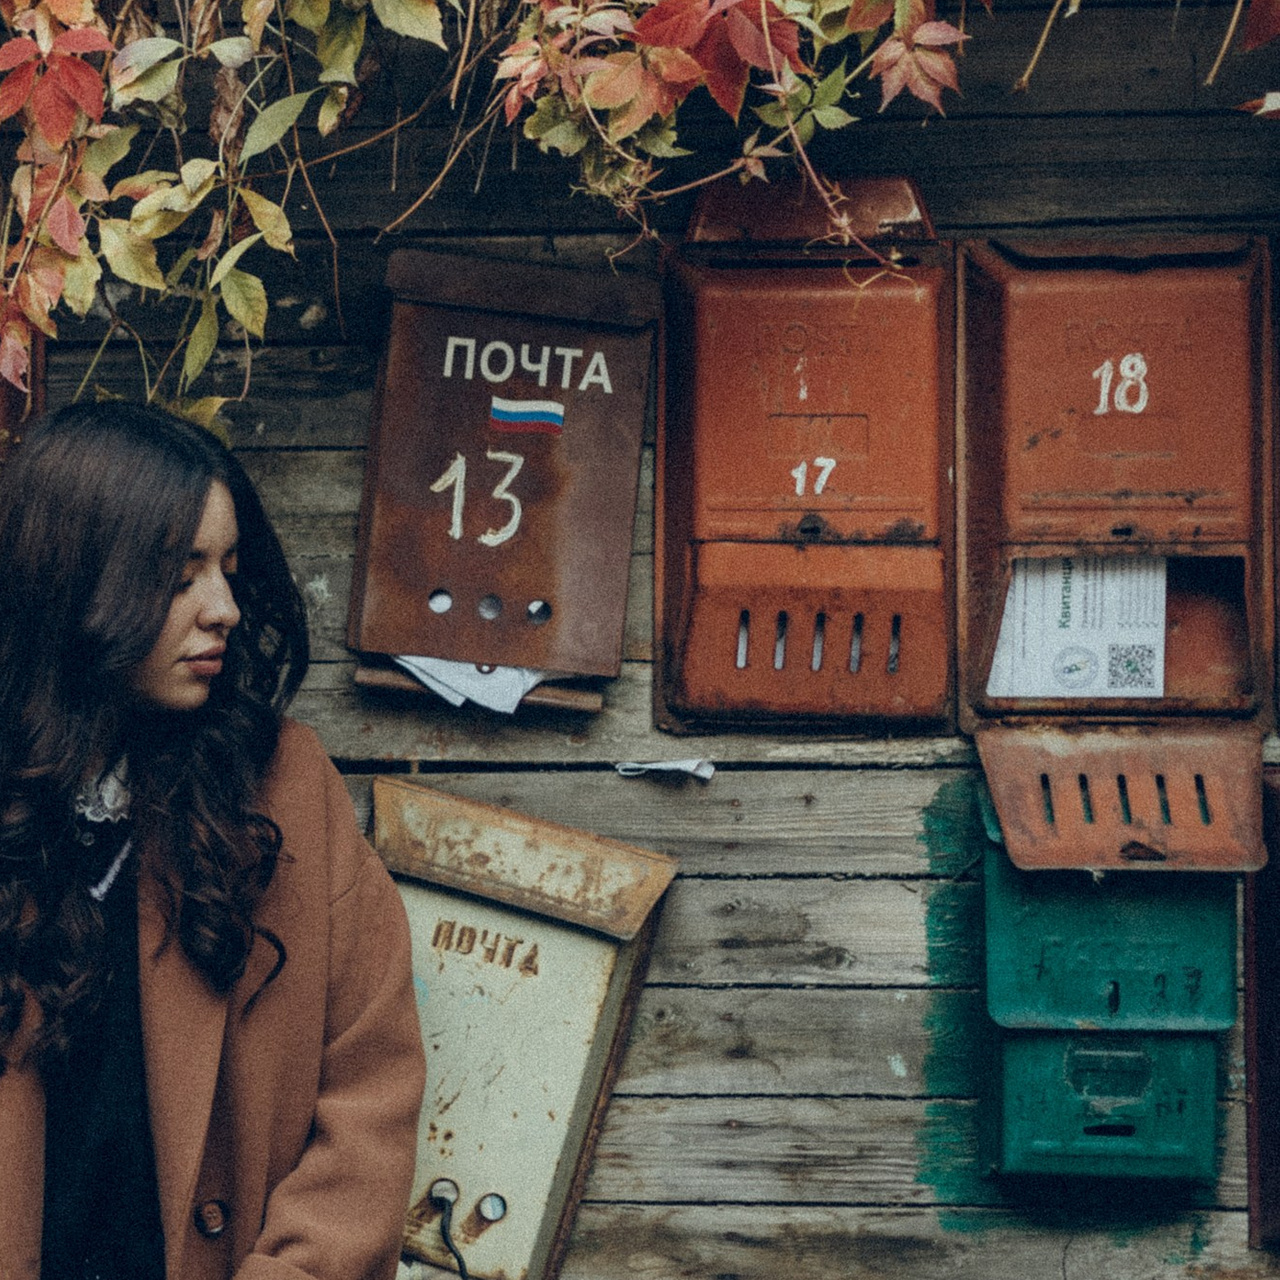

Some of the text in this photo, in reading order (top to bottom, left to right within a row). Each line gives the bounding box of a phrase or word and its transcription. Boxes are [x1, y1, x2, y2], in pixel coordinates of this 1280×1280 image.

[443, 336, 613, 394] ПОЧТА
[1092, 352, 1149, 416] 18
[429, 448, 524, 547] 13
[791, 456, 837, 497] 17
[432, 919, 539, 976] ПОЧТА
